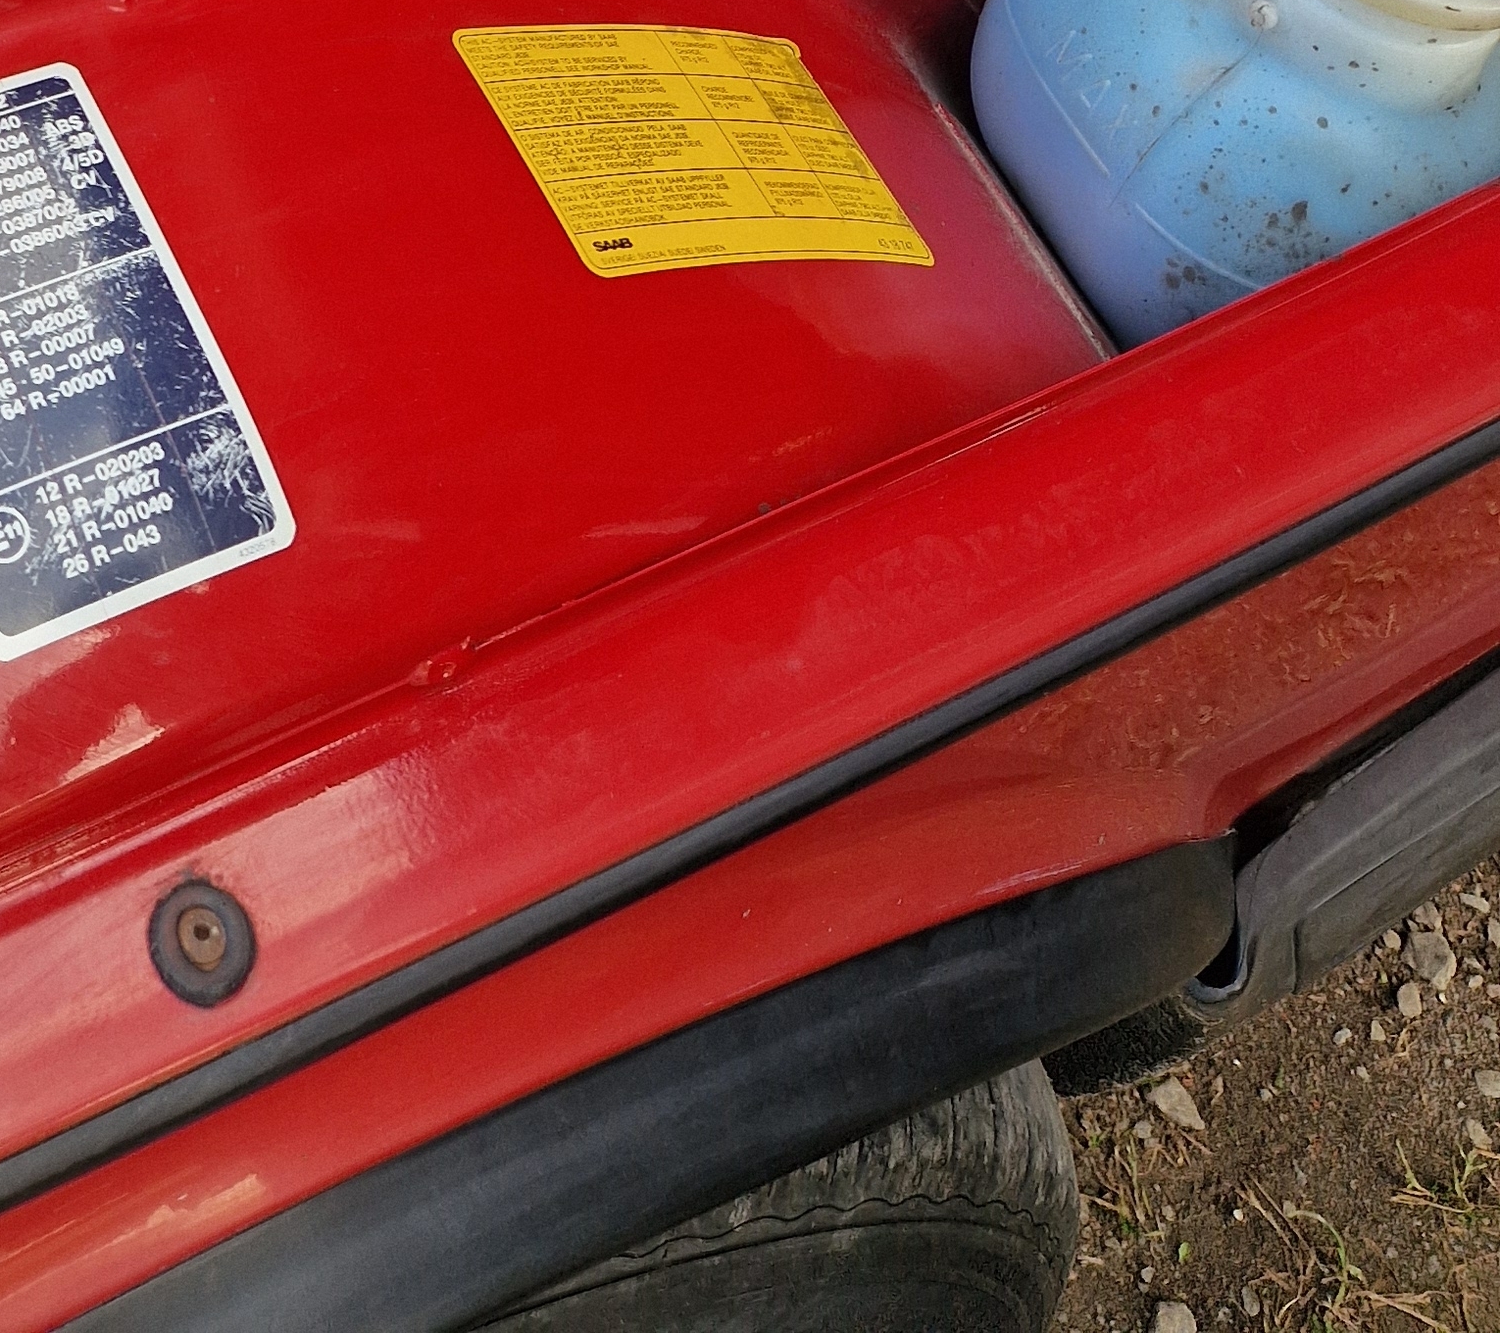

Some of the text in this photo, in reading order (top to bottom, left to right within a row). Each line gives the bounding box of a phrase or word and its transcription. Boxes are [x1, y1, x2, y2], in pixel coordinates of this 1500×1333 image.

[41, 112, 85, 138] ABS
[592, 237, 633, 251] SAAB
[8, 323, 99, 370] R-00007
[33, 439, 167, 506] 12 R-020203
[44, 503, 73, 530] 18
[51, 490, 177, 555] 21 R-01040
[59, 522, 164, 580] 26 R-043
